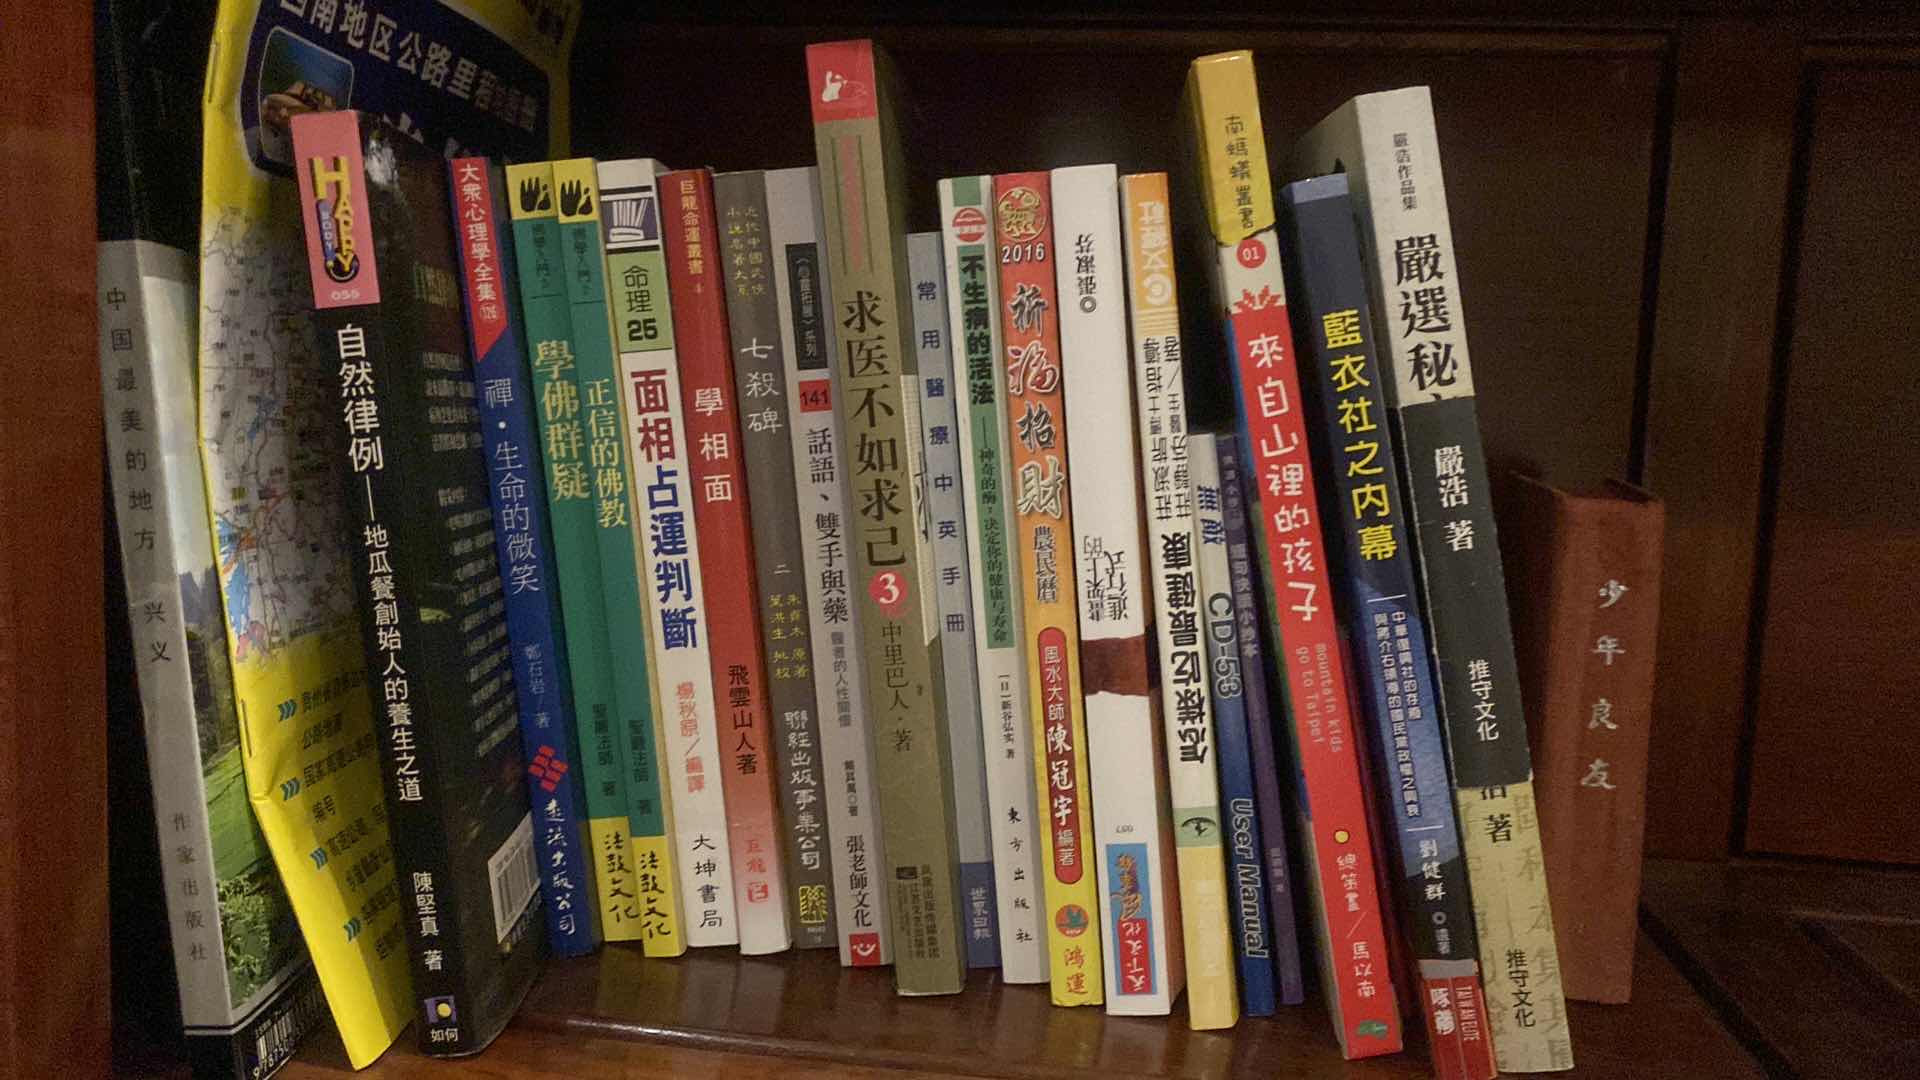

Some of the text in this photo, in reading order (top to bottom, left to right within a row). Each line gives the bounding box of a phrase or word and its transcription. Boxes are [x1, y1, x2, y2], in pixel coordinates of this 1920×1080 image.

[309, 155, 356, 273] HAPPY
[1001, 243, 1046, 264] 2016
[1242, 246, 1260, 261] 01
[623, 264, 653, 313] 命理
[961, 255, 995, 405] 不生病的活法
[1394, 233, 1459, 402] 嚴選秘
[336, 322, 385, 472] 自然律例
[534, 340, 591, 502] 學佛群疑
[740, 337, 783, 434] 七殺碑
[800, 390, 830, 407] 141
[1322, 309, 1398, 562] 藍衣社之內幕
[106, 287, 172, 663] 中国最美的地方 兴义
[584, 377, 629, 529] 正信的佛教
[695, 387, 733, 504] 學相面
[842, 289, 908, 605] 求医不如求己 3
[917, 281, 966, 633] 常用醫療中英手冊
[1434, 444, 1475, 553] 嚴浩 著
[630, 368, 698, 650] 面相占運判斷
[806, 427, 850, 625] 話語、雙手與藥
[1161, 531, 1208, 764] 怎樣吃最健康
[1207, 592, 1242, 698] CD-53
[1296, 646, 1311, 664] go
[1302, 670, 1315, 688] to
[1580, 579, 1629, 790] 少年良友
[728, 664, 759, 775] 飛雲山人著
[1468, 659, 1499, 742] 推守文化
[784, 710, 822, 871] 聯經出版事業公司
[1484, 814, 1513, 844] 著
[172, 813, 207, 961] 作家出版社
[413, 872, 440, 937] 陳堅真
[604, 833, 641, 923] 法鼓文化
[639, 852, 673, 939] 法鼓文化
[692, 833, 722, 929] 大坤書局
[847, 834, 873, 928] 張老師文化
[970, 887, 992, 940] 世界日報
[1231, 798, 1270, 959] User Manual
[1064, 948, 1088, 995] 鴻運
[1122, 921, 1147, 993] 天下文化
[1506, 949, 1537, 1027] 推守文化
[429, 1028, 459, 1042] 如何
